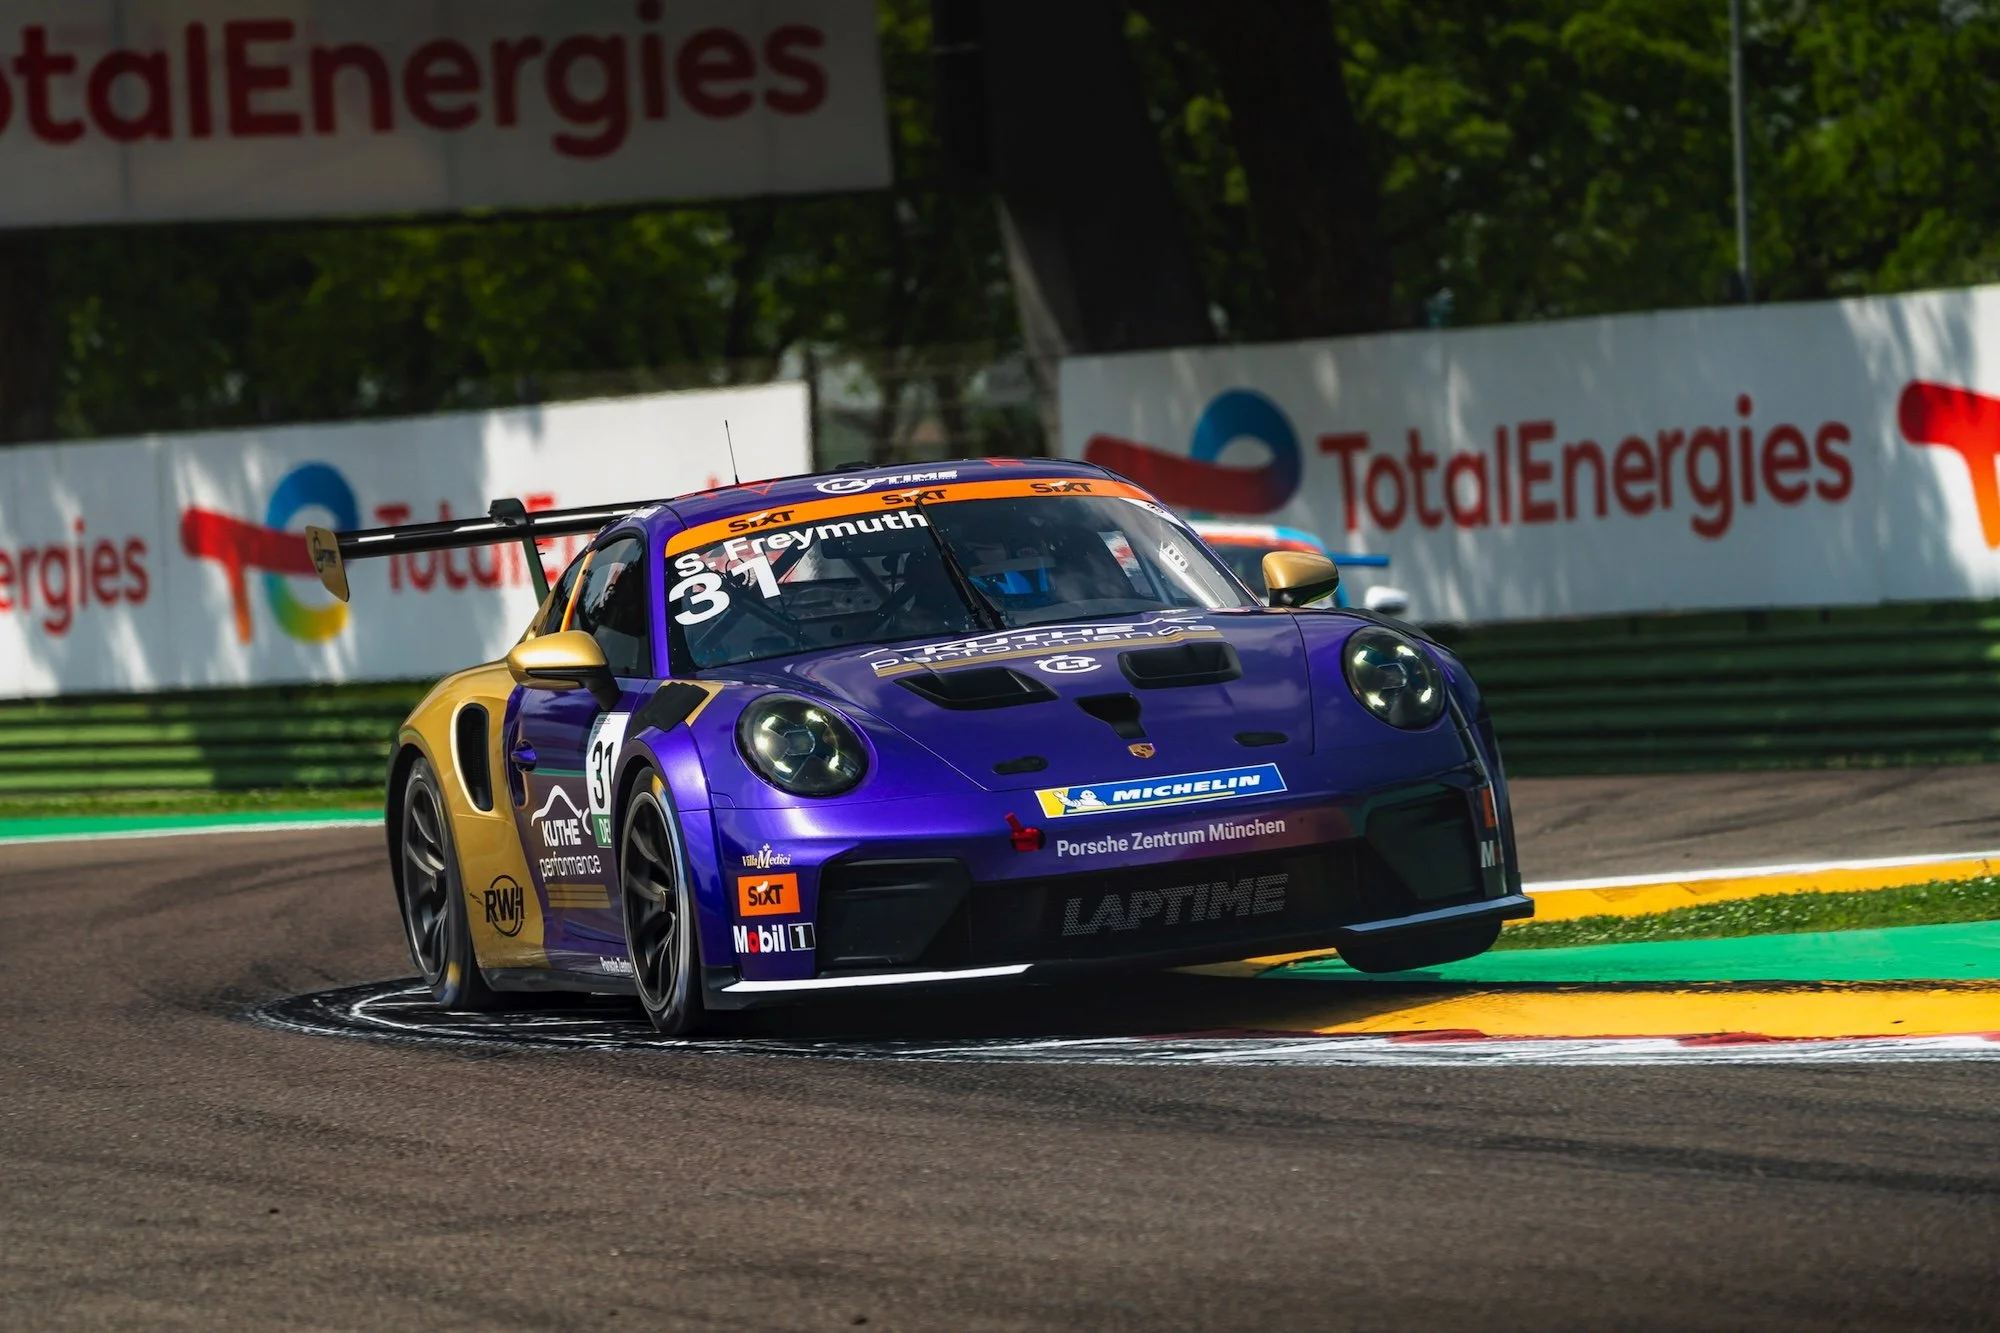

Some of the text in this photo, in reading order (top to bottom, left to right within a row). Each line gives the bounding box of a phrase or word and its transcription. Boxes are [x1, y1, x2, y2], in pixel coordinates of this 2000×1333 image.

[0, 0, 829, 161] talEnergies
[831, 469, 958, 491] LAPTIME
[1318, 394, 1854, 541] TotalEnergies
[674, 510, 929, 578] S. Freymuth
[669, 556, 781, 626] 31
[923, 626, 1135, 656] KUTHE
[592, 740, 614, 809] 31
[1112, 775, 1261, 802] MICHELIN
[541, 818, 582, 847] KUTHE
[1056, 818, 1286, 858] Porsche Zentrum München
[539, 851, 602, 883] performance
[1061, 873, 1289, 937] LAPTIME
[733, 924, 786, 954] Mobil
